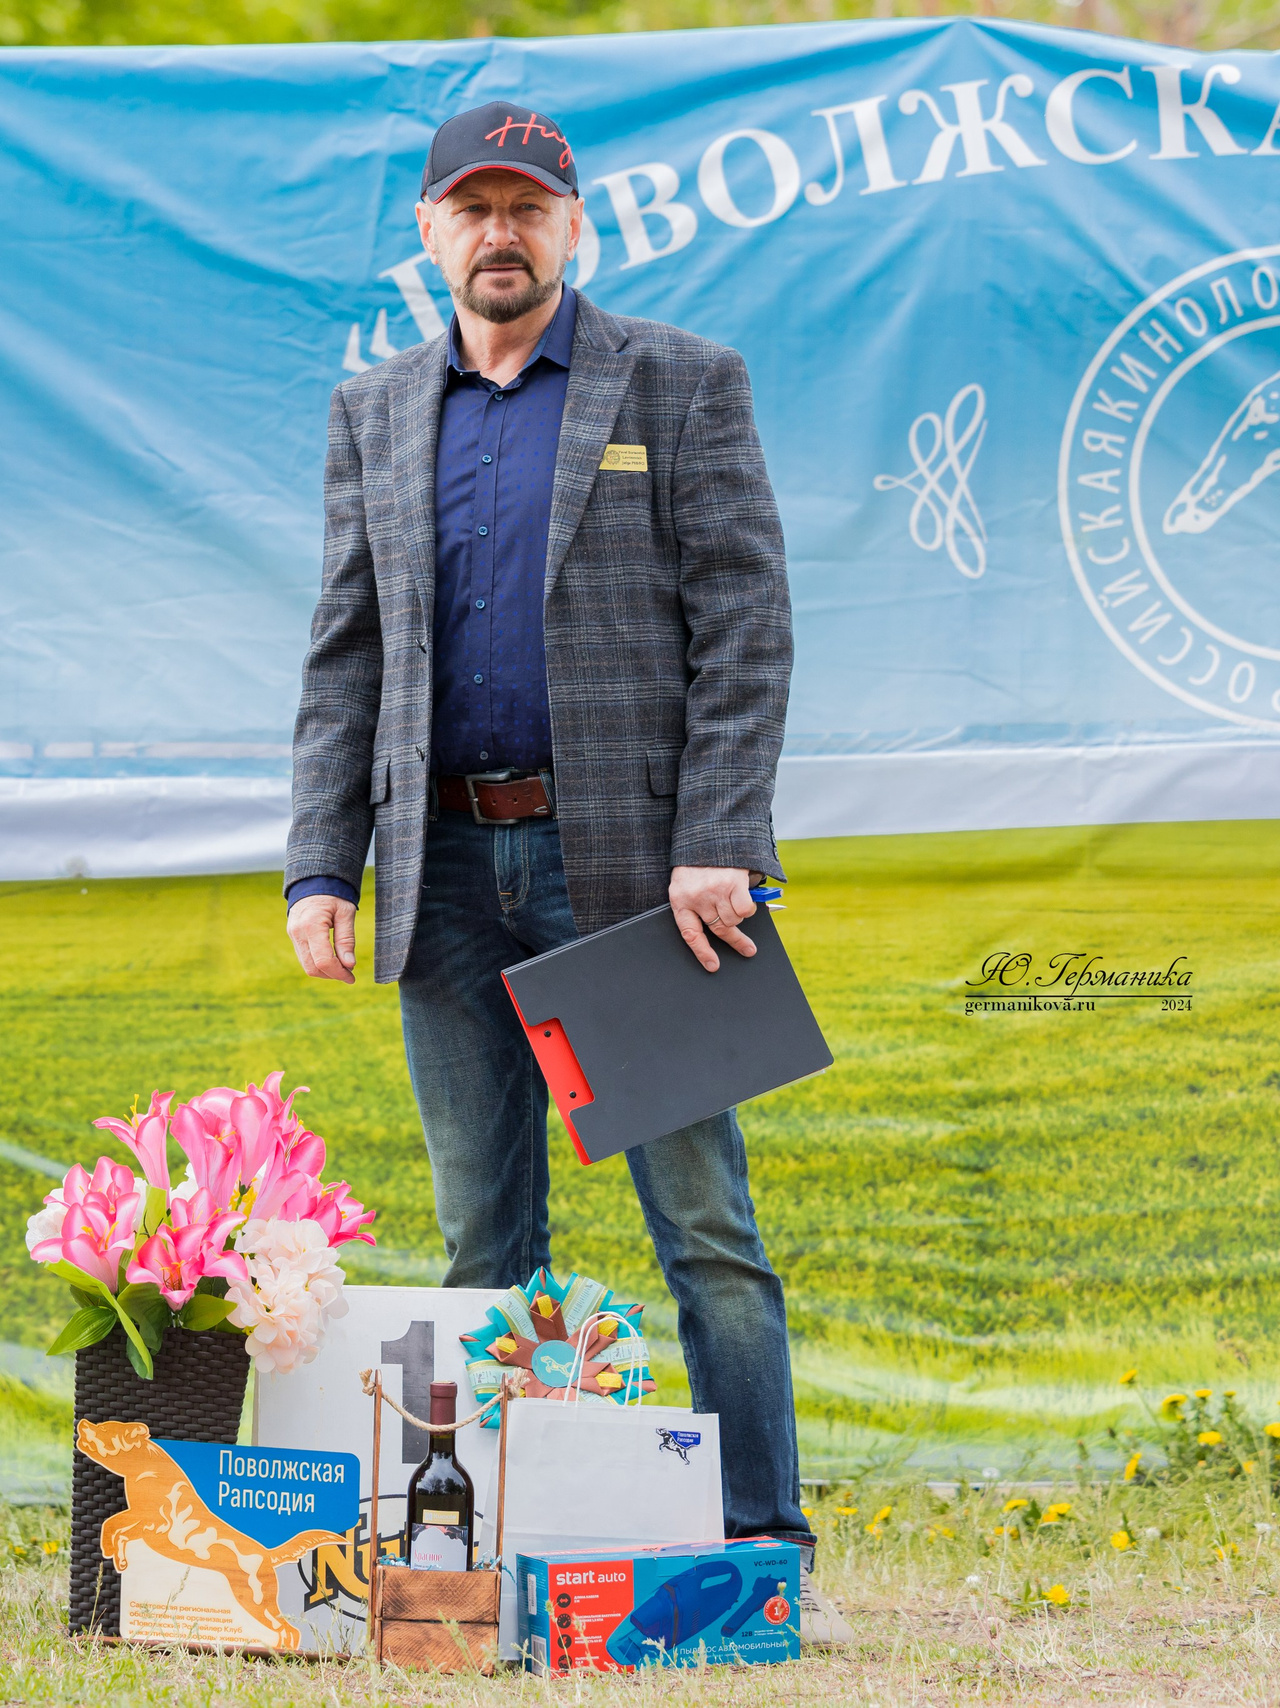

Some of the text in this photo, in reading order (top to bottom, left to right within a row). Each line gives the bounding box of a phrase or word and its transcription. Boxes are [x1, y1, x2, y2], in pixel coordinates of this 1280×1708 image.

[381, 1320, 435, 1464] 1
[219, 1449, 346, 1484] Поволжская
[218, 1481, 316, 1516] Рапсодия
[753, 1559, 788, 1567] VC-WD-60
[555, 1570, 595, 1586] start
[597, 1572, 627, 1583] auto
[179, 1605, 231, 1615] региональная
[773, 1606, 780, 1616] 1
[186, 1614, 233, 1624] организация
[223, 1626, 243, 1634] Клуб
[679, 1643, 717, 1655] ПЫЛОС
